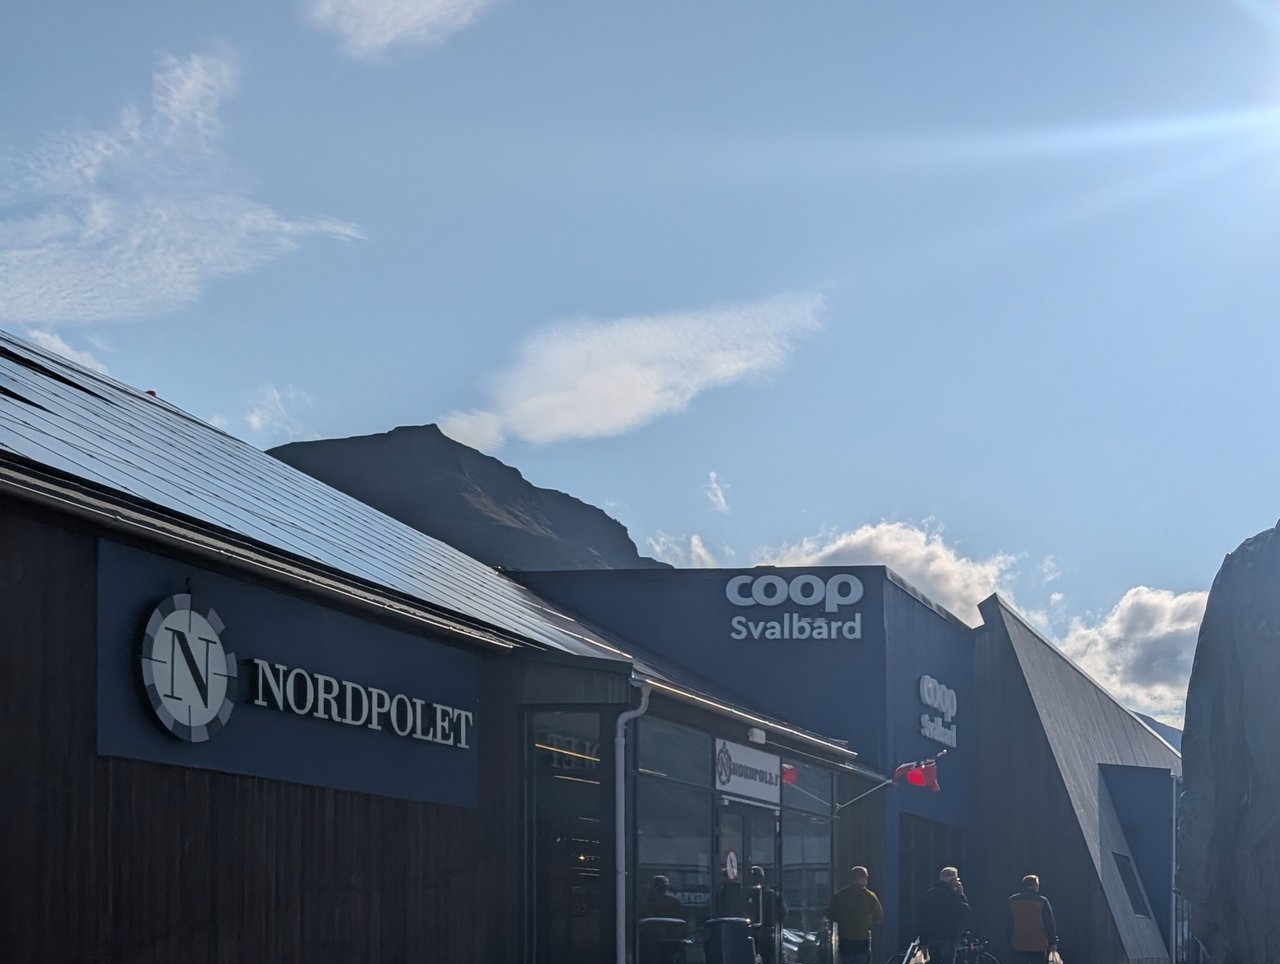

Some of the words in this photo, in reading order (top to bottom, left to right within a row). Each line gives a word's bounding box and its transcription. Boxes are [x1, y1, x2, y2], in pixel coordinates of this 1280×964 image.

[725, 573, 864, 612] coop
[730, 612, 862, 640] Svalbard
[164, 626, 217, 710] N
[253, 657, 473, 750] NORDPOLET
